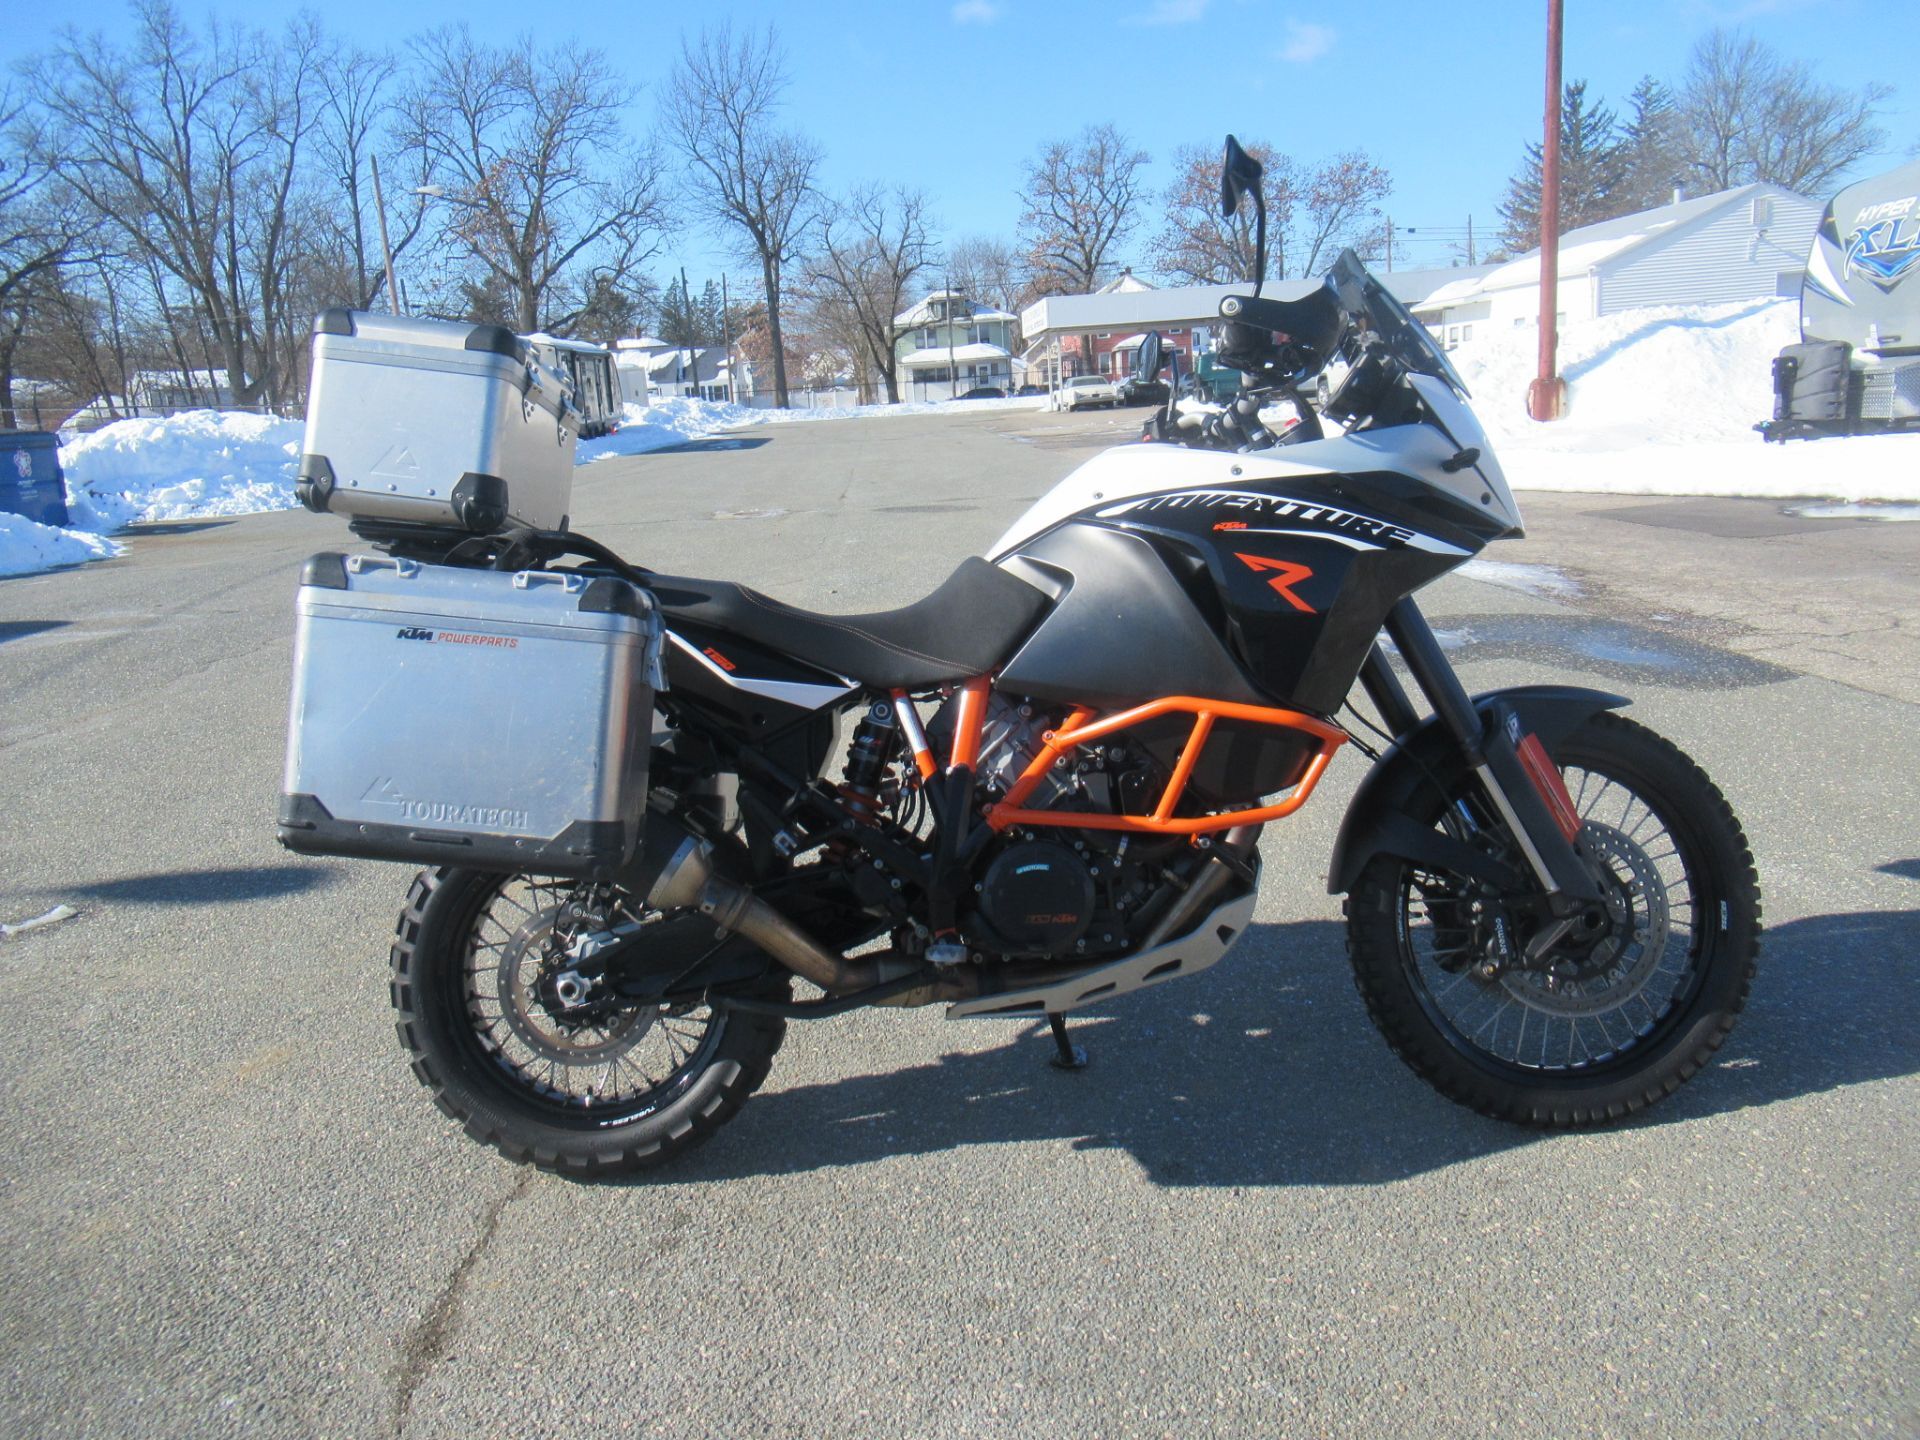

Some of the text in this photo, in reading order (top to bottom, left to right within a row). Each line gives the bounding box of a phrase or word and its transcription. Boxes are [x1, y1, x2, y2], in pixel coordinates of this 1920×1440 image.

[1855, 196, 1917, 224] HYPER
[1844, 214, 1920, 281] XL
[1120, 490, 1416, 545] ADVENTURE
[1233, 552, 1318, 614] R
[397, 627, 519, 649] KTM POWERPARTS
[400, 800, 529, 829] TOURATECH
